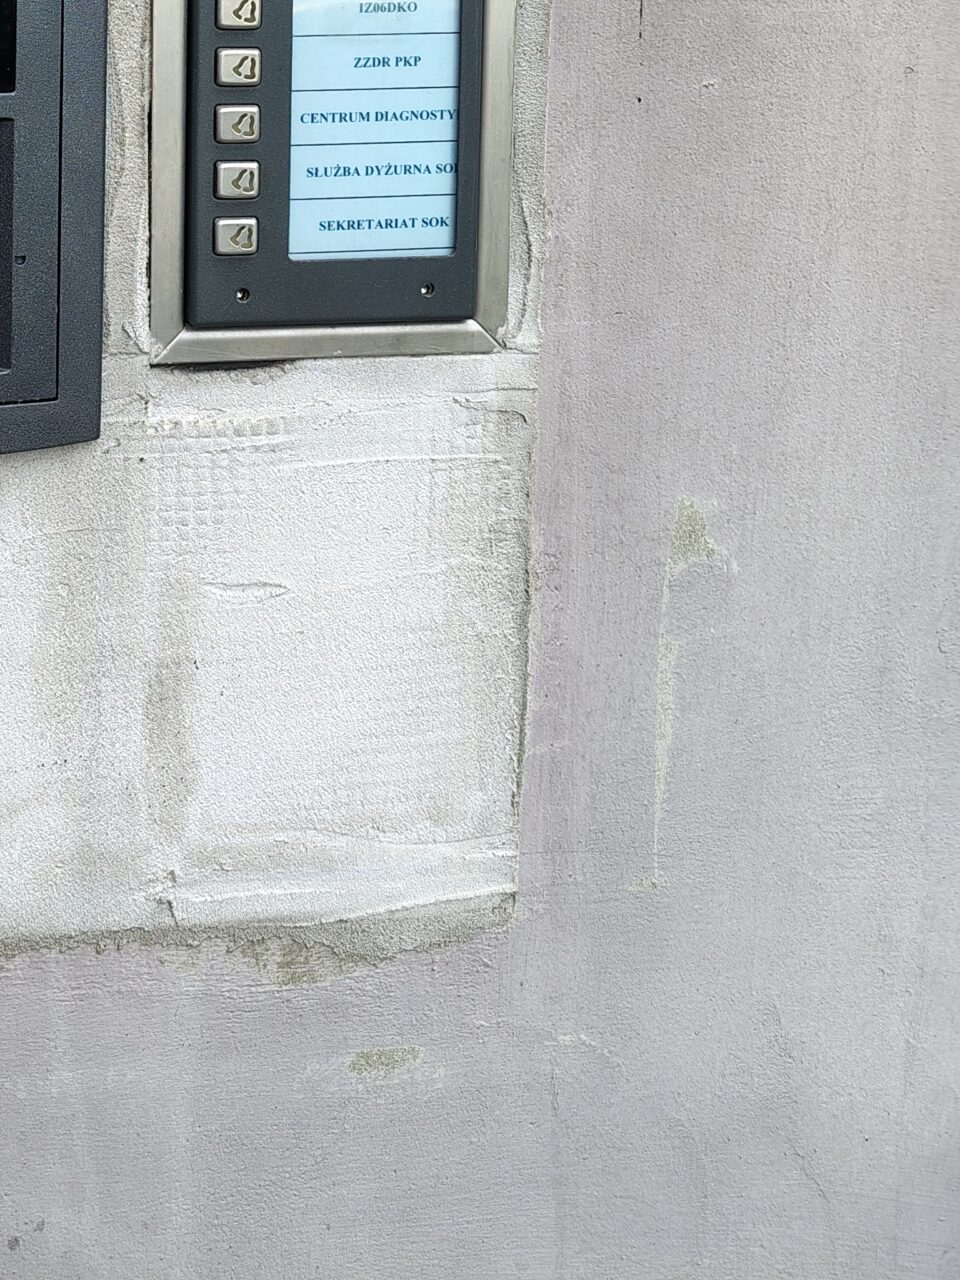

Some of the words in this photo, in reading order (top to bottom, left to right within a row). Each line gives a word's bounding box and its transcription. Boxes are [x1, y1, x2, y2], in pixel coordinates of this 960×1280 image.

[359, 2, 418, 13] IZ06DKO
[353, 57, 391, 68] ZZDR
[395, 56, 422, 68] PKP
[300, 111, 371, 124] CENTRUM
[306, 163, 361, 177] SŁUŻBA
[365, 163, 432, 177] DYŻURNA
[318, 218, 418, 232] SEKRETARIAT
[421, 216, 450, 228] SOK
